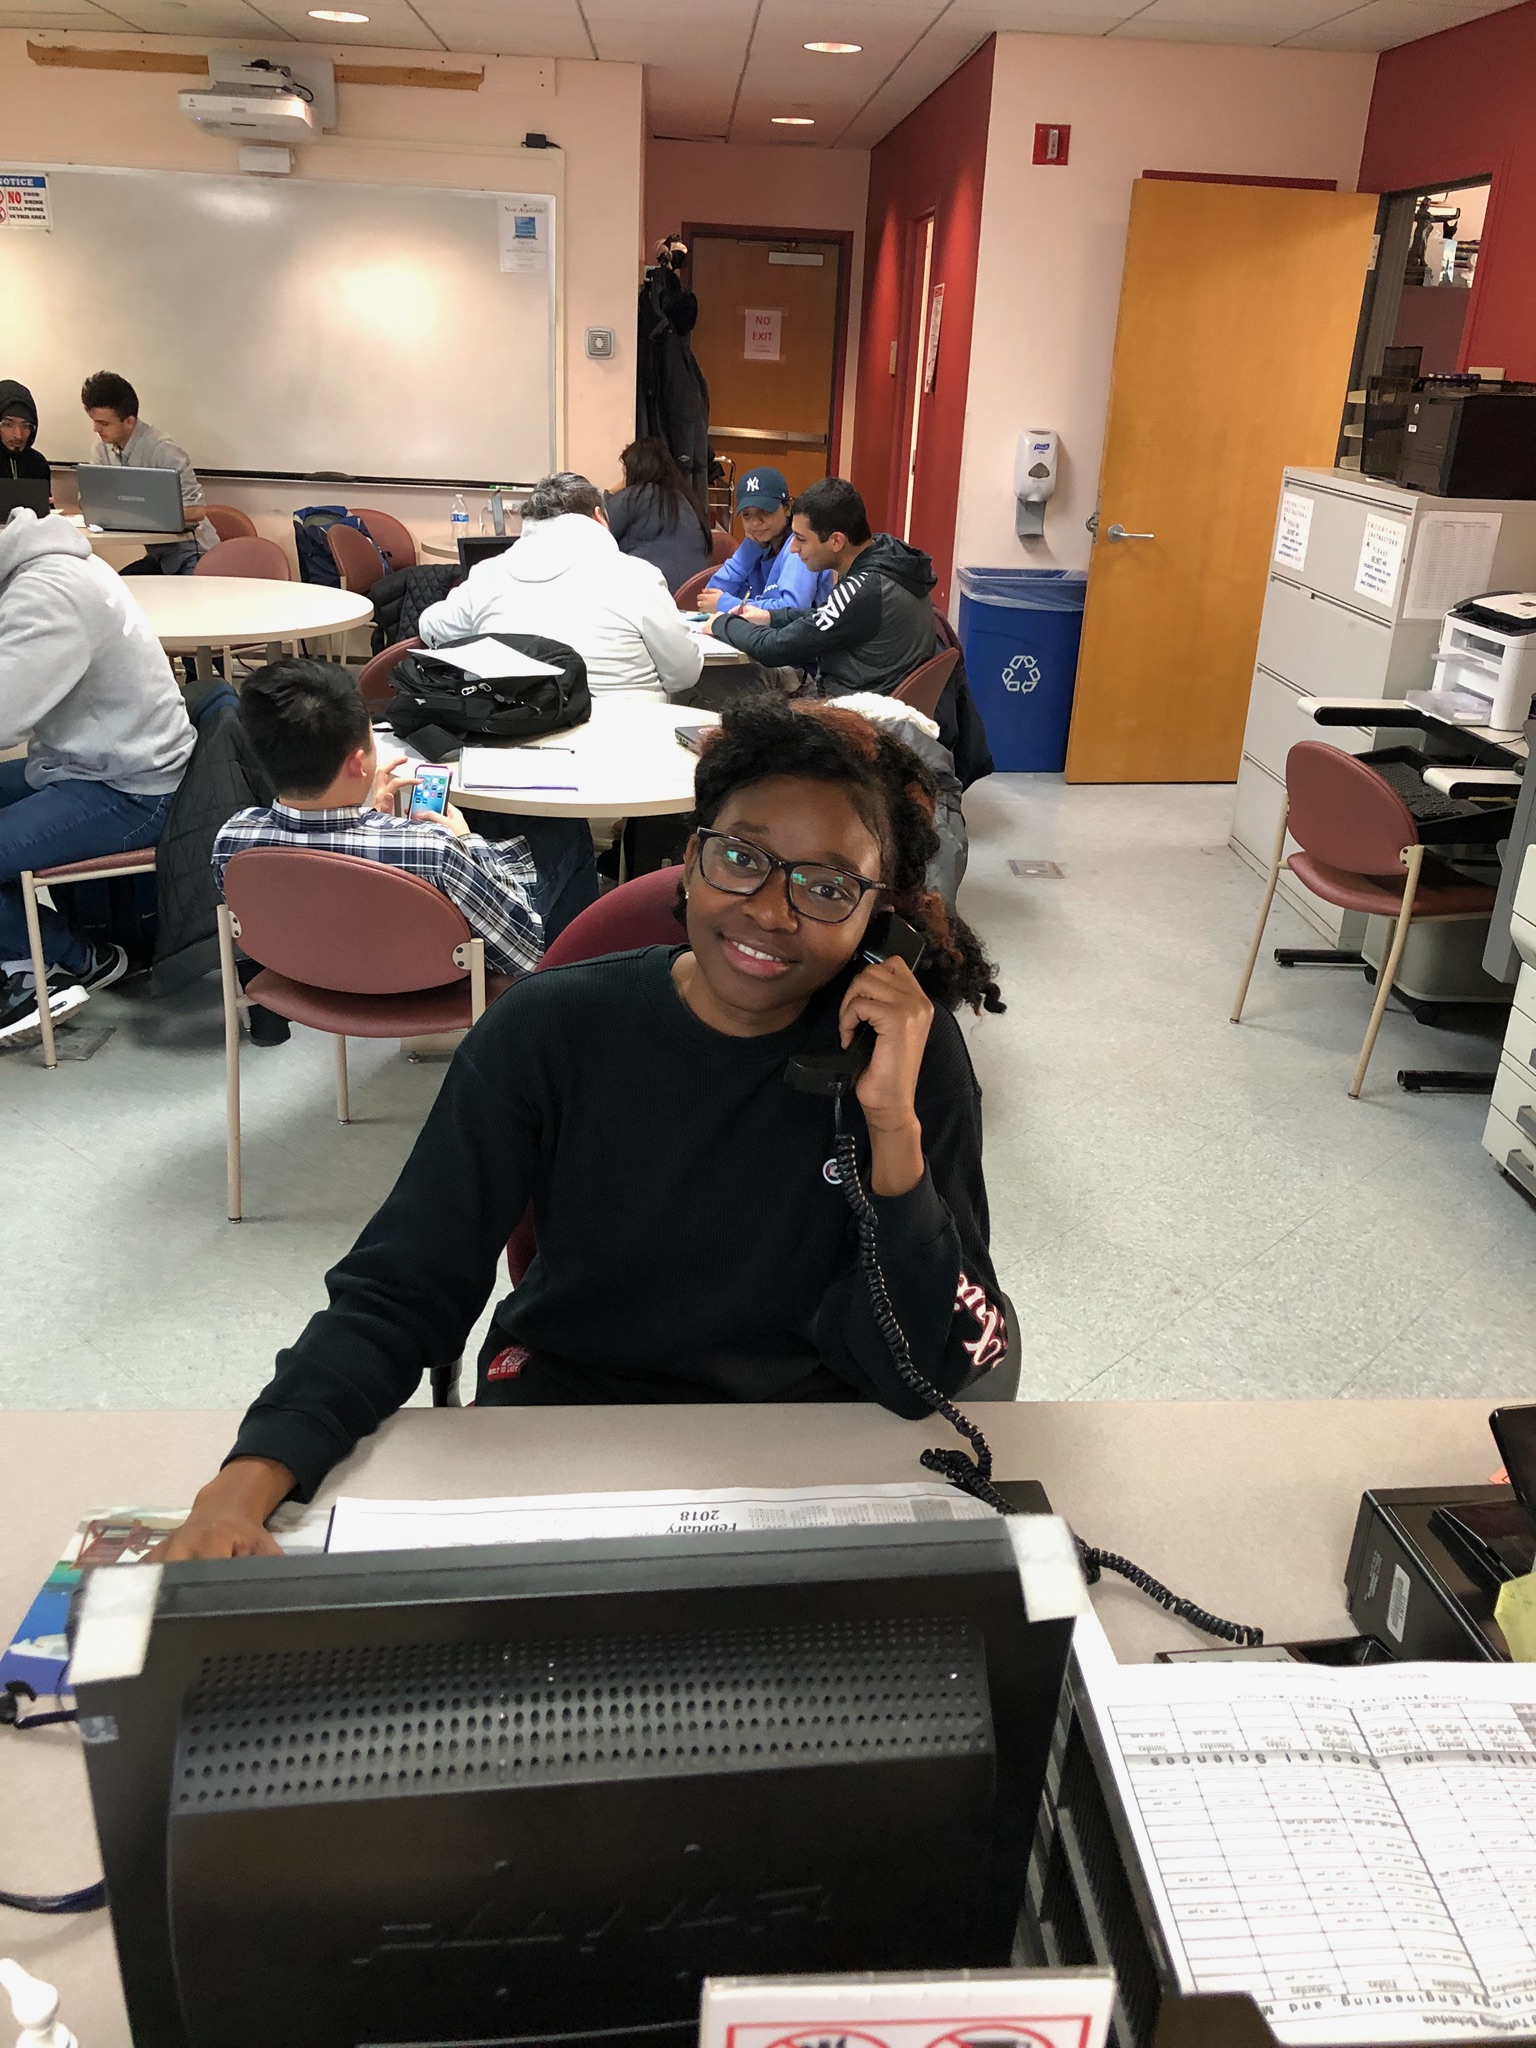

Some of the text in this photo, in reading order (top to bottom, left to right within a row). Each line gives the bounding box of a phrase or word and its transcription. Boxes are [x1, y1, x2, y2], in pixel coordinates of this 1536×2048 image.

[7, 191, 22, 204] NO
[755, 316, 771, 326] NO
[752, 331, 773, 341] EXIT
[680, 1509, 720, 1521] 2018
[1150, 1753, 1267, 1767] Sciences
[1288, 2000, 1322, 2013] and
